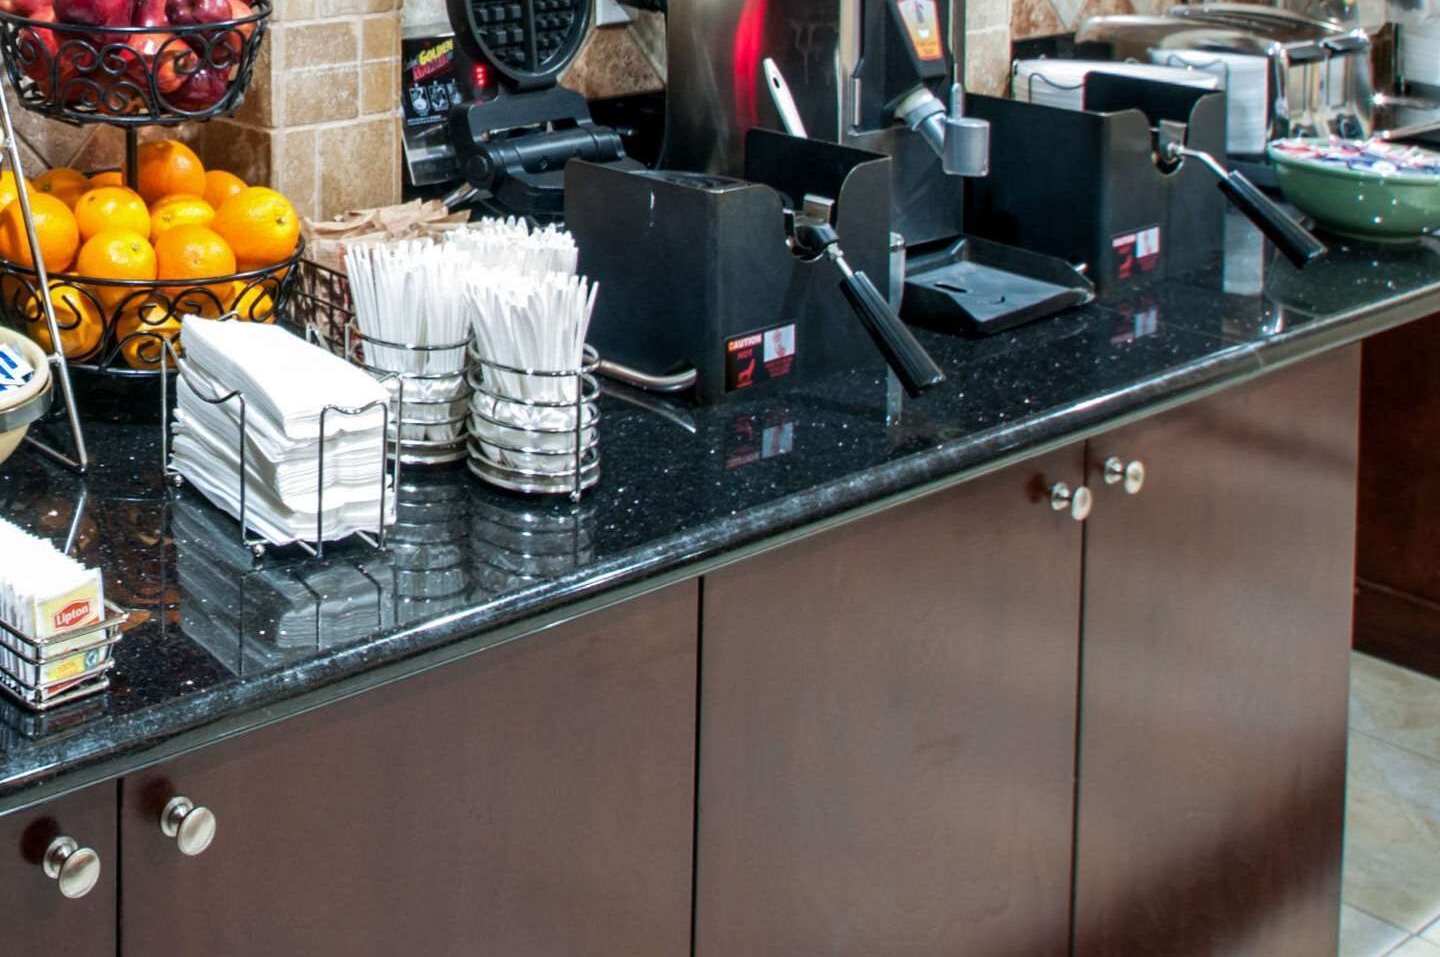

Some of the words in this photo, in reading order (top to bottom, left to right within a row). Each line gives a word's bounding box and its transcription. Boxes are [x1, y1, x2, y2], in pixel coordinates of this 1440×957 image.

[419, 38, 453, 65] GOLDEN
[728, 333, 762, 352] CAUTION
[56, 604, 89, 626] Lipton
